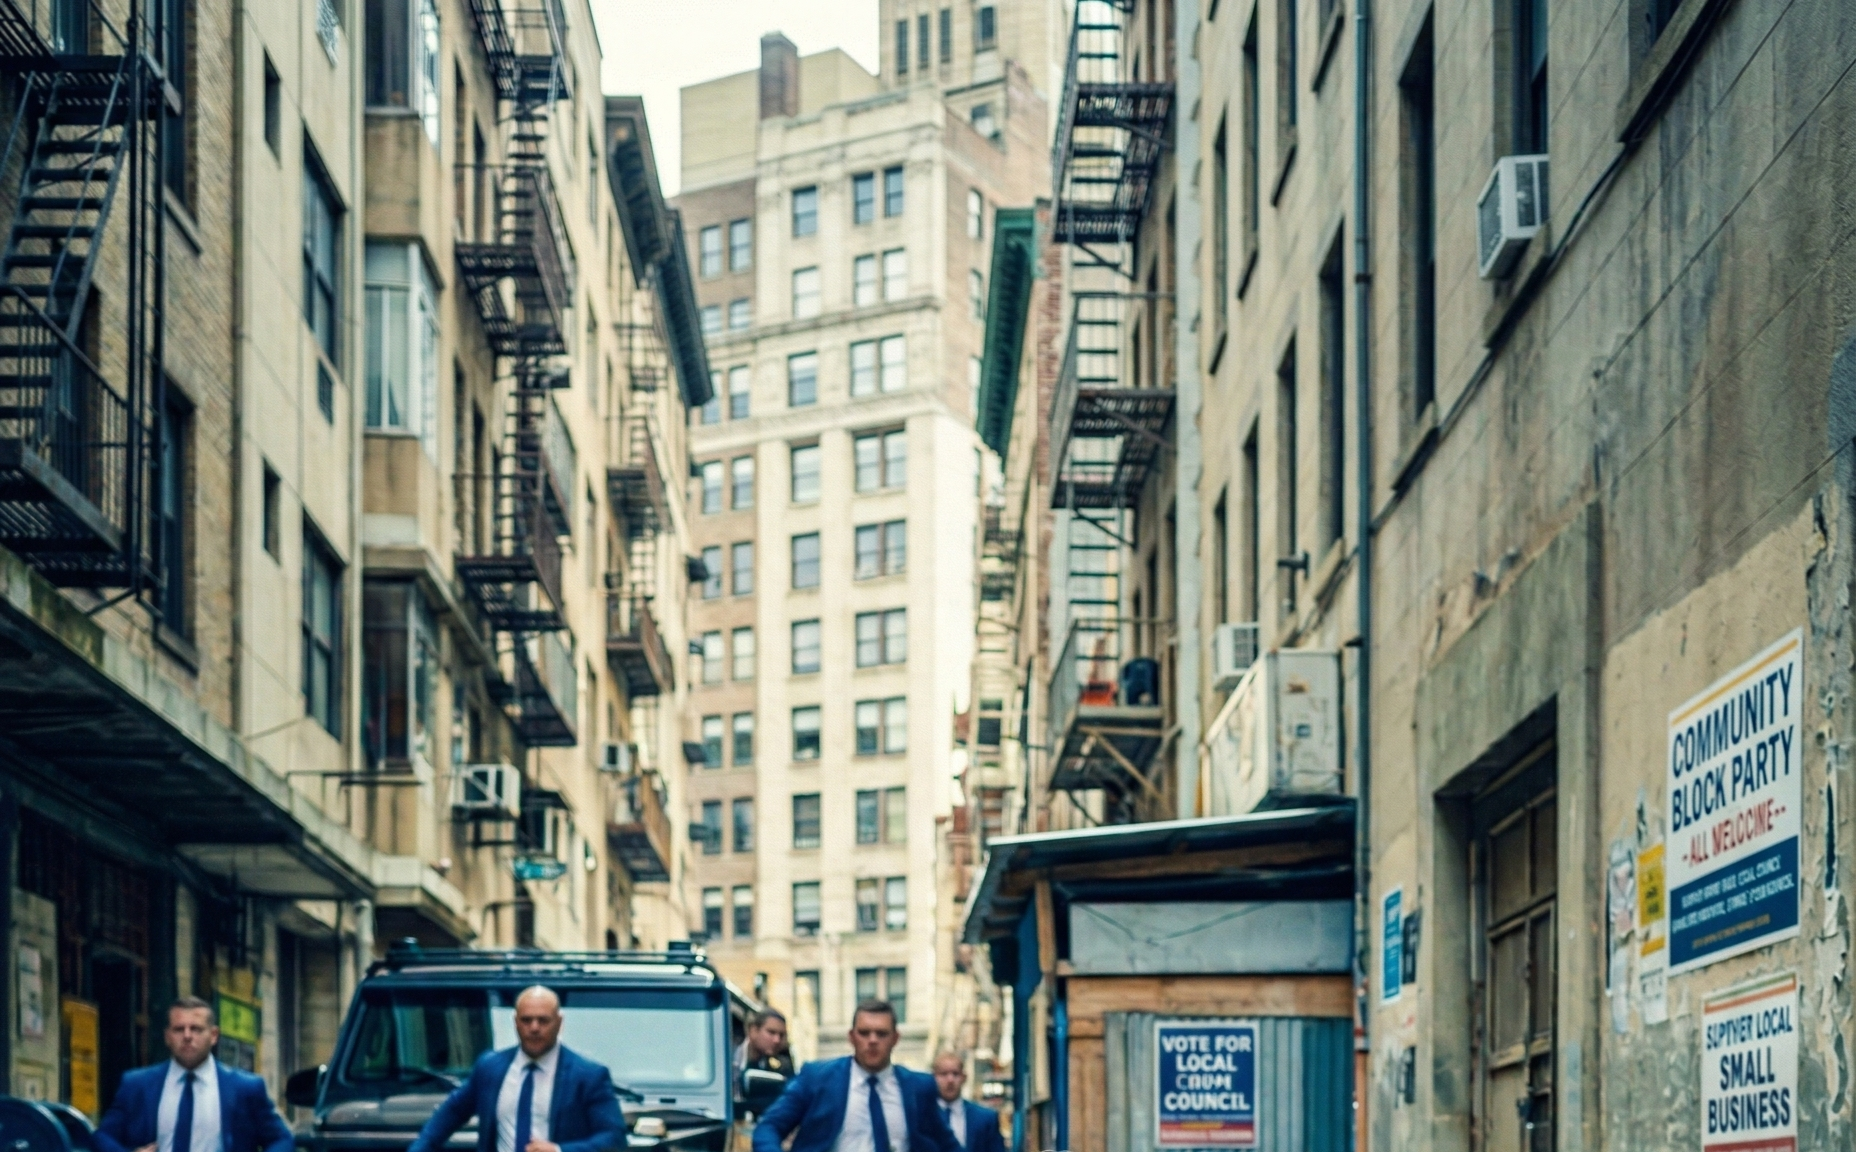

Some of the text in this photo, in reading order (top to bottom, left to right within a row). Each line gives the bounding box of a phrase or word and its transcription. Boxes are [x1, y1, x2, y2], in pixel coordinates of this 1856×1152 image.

[1672, 662, 1794, 779] COMMUNITY
[1672, 725, 1794, 833] BLOCK PARTY
[1756, 1005, 1793, 1040] LOCAL
[1161, 1034, 1252, 1053] VOTE FOR
[1175, 1053, 1238, 1072] LOCAL
[1719, 1046, 1775, 1091] SMALL
[1163, 1091, 1252, 1112] COUNCIL
[1708, 1087, 1791, 1134] BUSINESS
